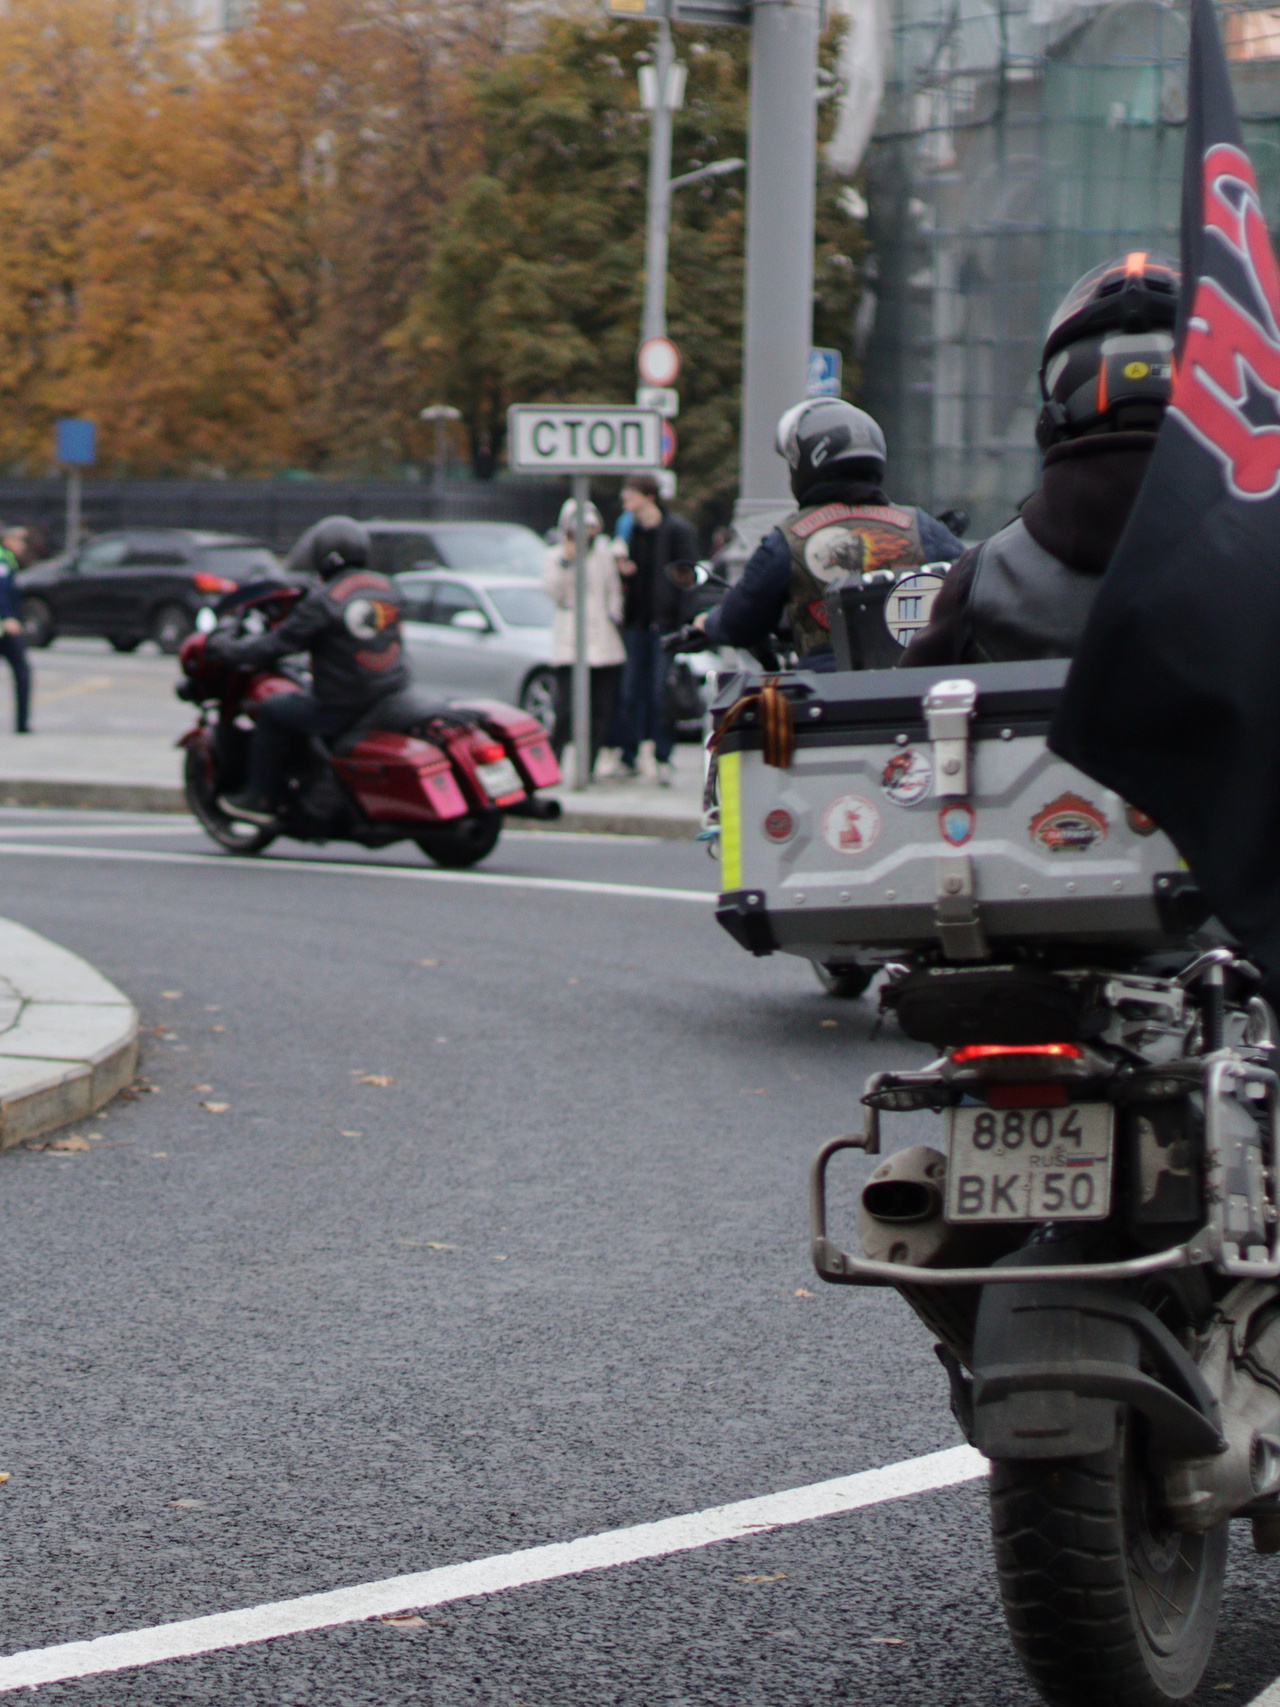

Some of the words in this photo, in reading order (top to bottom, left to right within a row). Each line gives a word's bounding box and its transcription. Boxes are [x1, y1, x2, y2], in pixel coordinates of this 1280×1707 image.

[532, 420, 643, 458] СТОП
[973, 1109, 1082, 1150] 8804
[1030, 1154, 1067, 1167] RUS
[1042, 1172, 1095, 1211] 50
